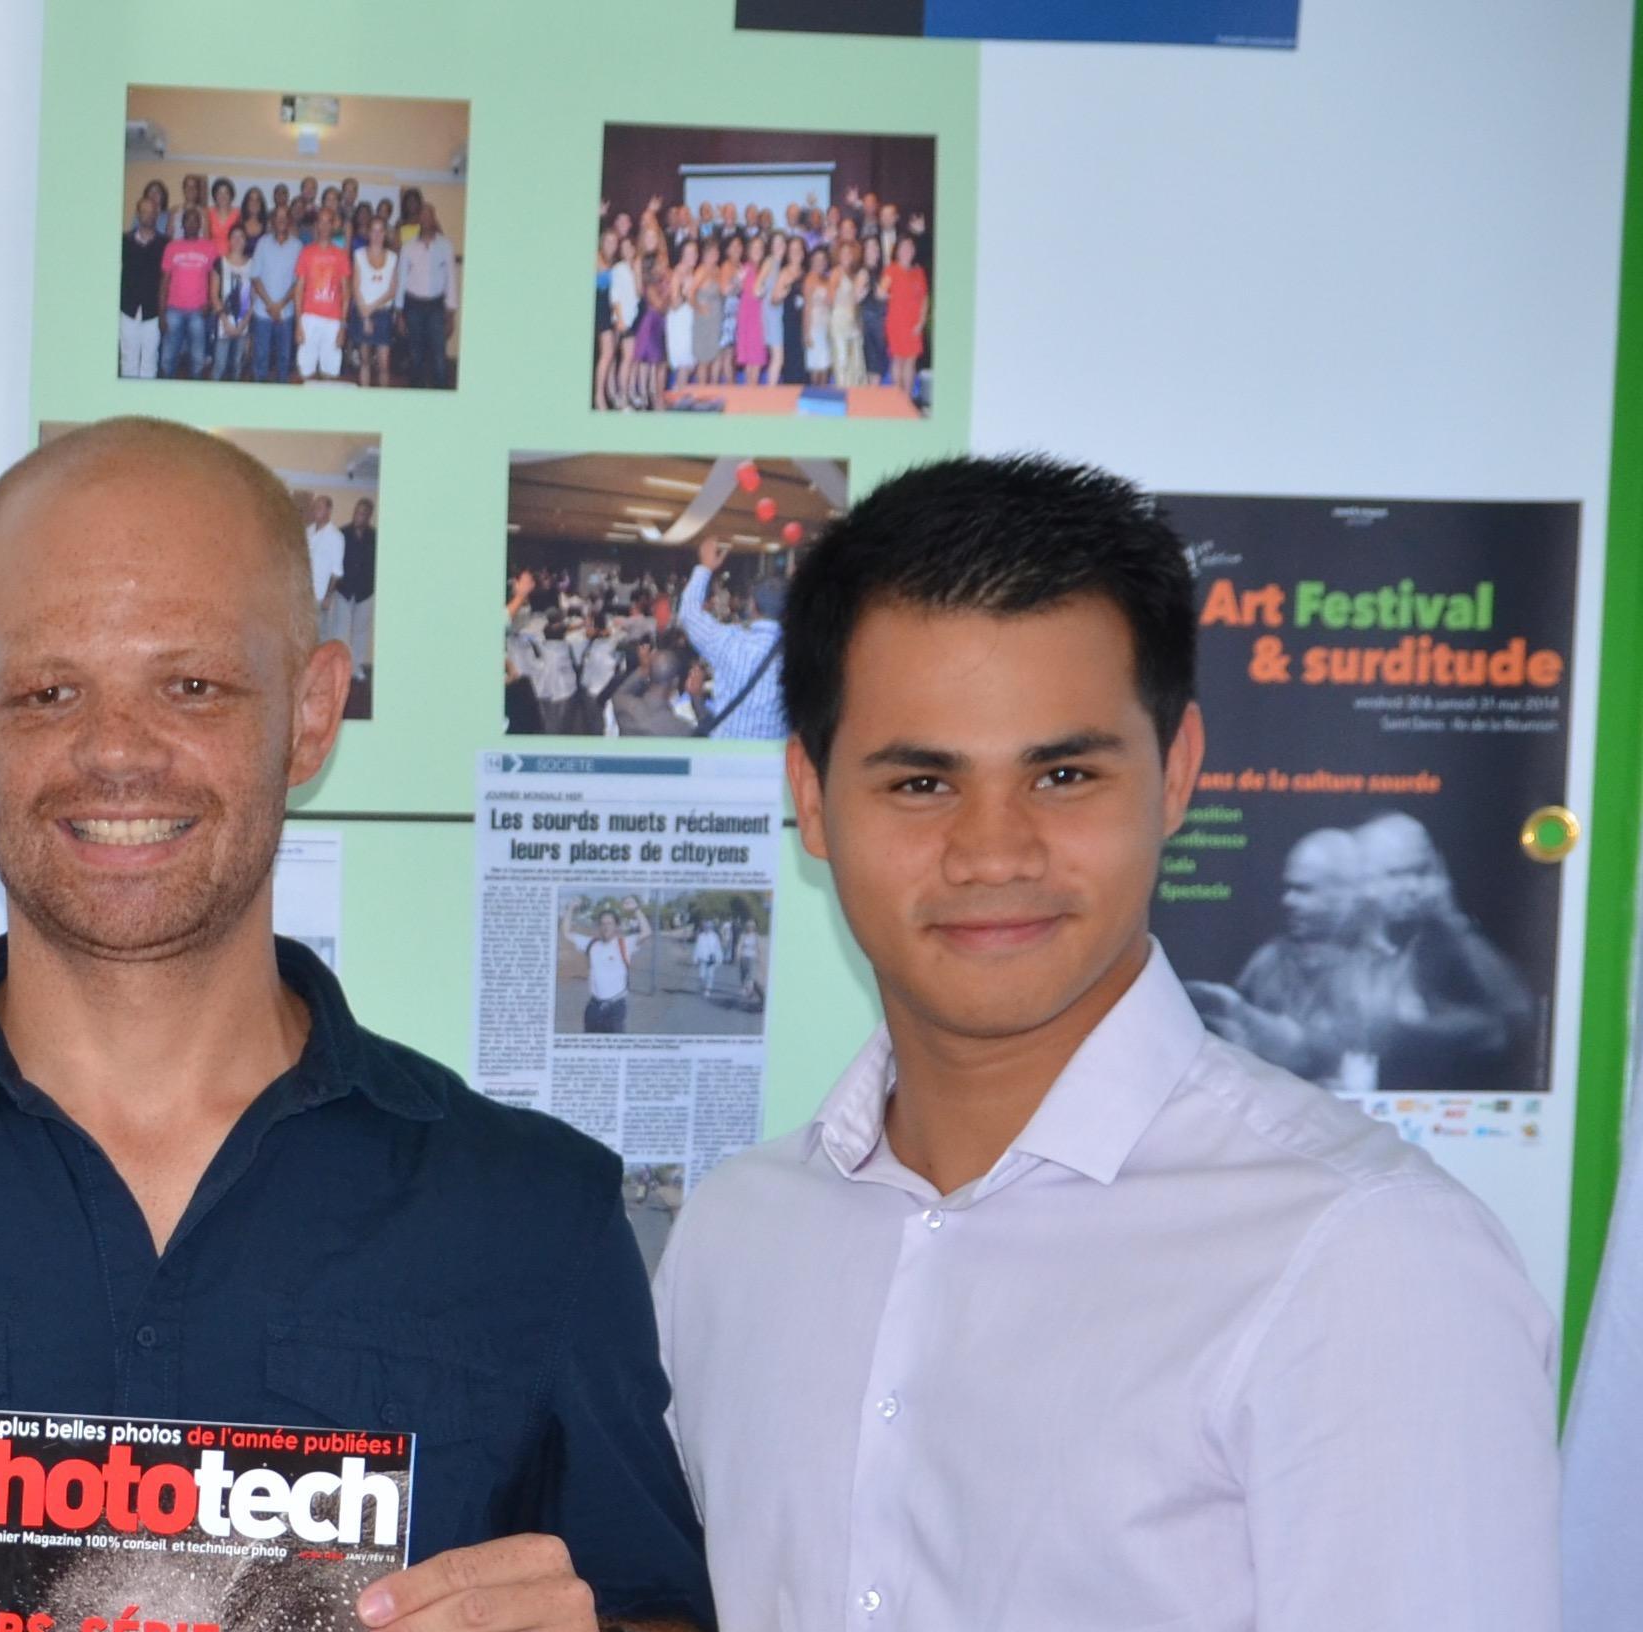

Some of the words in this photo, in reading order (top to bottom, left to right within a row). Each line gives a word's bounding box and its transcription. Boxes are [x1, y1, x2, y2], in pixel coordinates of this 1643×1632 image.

[1199, 578, 1286, 627] Art
[1294, 578, 1494, 631] Festival
[1248, 635, 1291, 684] &
[1302, 635, 1563, 687] surditude
[1237, 768, 1265, 792] de
[1268, 768, 1289, 792] la
[1290, 769, 1363, 792] culture
[1367, 769, 1442, 793] sourde
[491, 808, 522, 830] Les
[532, 809, 599, 832] sourds
[608, 811, 666, 832] muets
[675, 808, 770, 834] réclament
[511, 838, 561, 861] leurs
[569, 839, 631, 865] places
[640, 839, 662, 862] de
[671, 840, 749, 866] citoyens
[46, 1418, 106, 1440] belles
[111, 1422, 182, 1445] photos
[187, 1424, 214, 1446] de
[220, 1427, 298, 1450] l'année
[304, 1431, 391, 1455] publiées
[22, 1530, 82, 1548] Magazine
[85, 1534, 120, 1549] 100%
[122, 1537, 167, 1552] conseil
[171, 1541, 186, 1552] et
[186, 1541, 249, 1559] technique
[251, 1544, 287, 1560] photo
